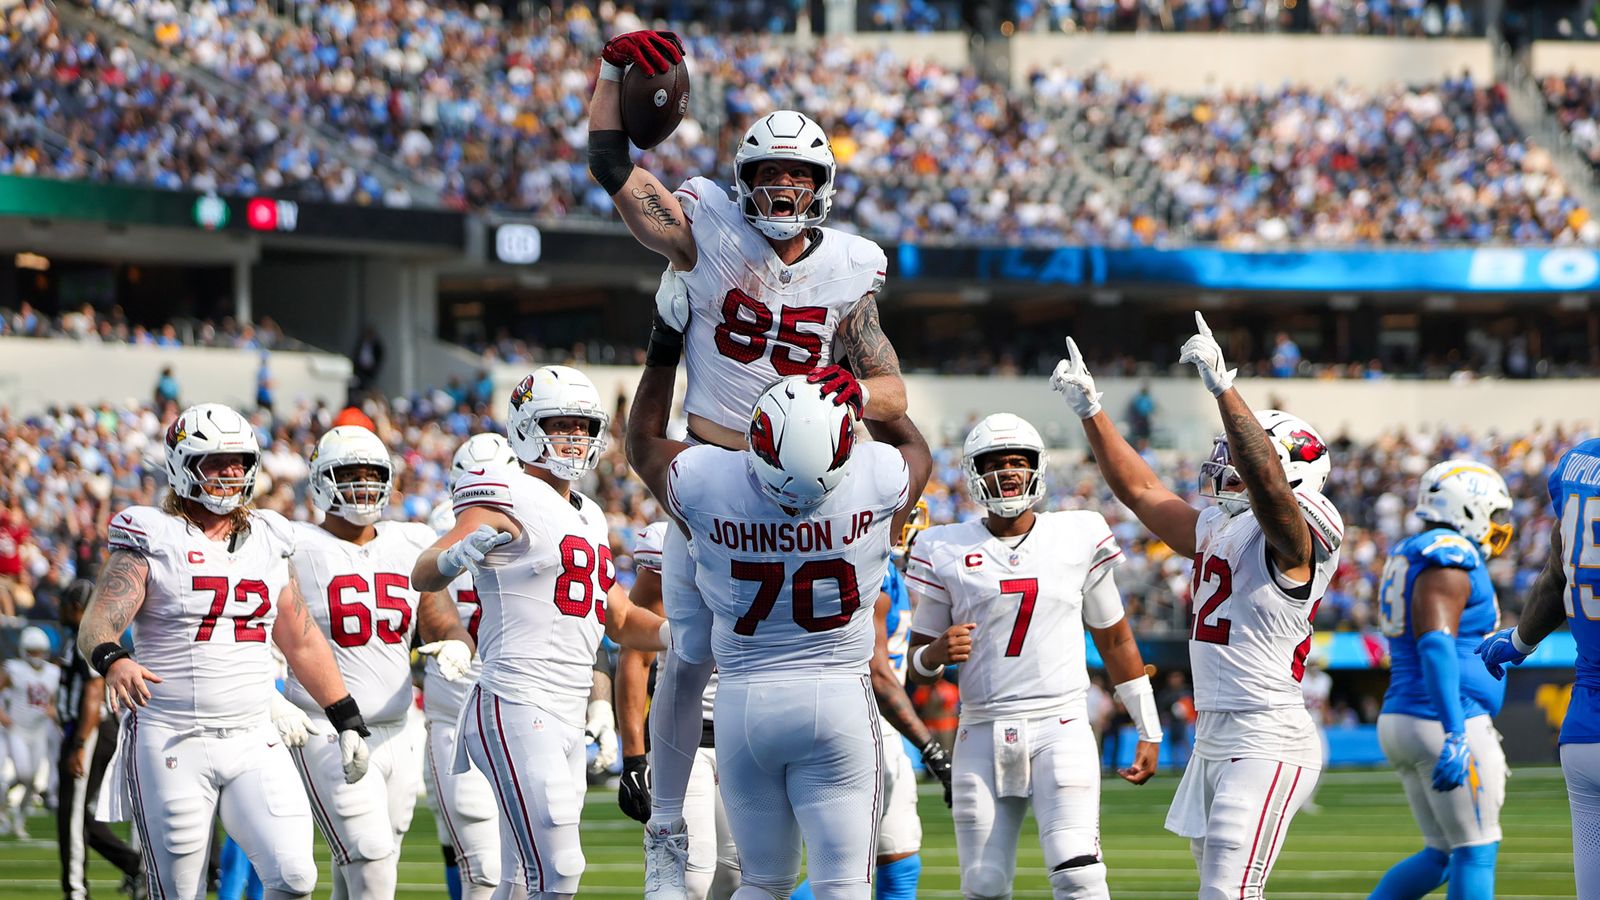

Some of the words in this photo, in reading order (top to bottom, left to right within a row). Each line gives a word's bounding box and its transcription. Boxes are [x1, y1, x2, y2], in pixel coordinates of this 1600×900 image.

[714, 287, 829, 376] 85
[188, 551, 205, 563] C
[709, 518, 833, 553] JOHNSON
[843, 510, 874, 545] JR
[1298, 501, 1336, 541] CARDINALS
[553, 534, 616, 626] 89
[965, 553, 983, 567] C
[191, 575, 272, 643] 72
[327, 572, 412, 648] 65
[730, 557, 861, 636] 70
[999, 577, 1039, 657] 7
